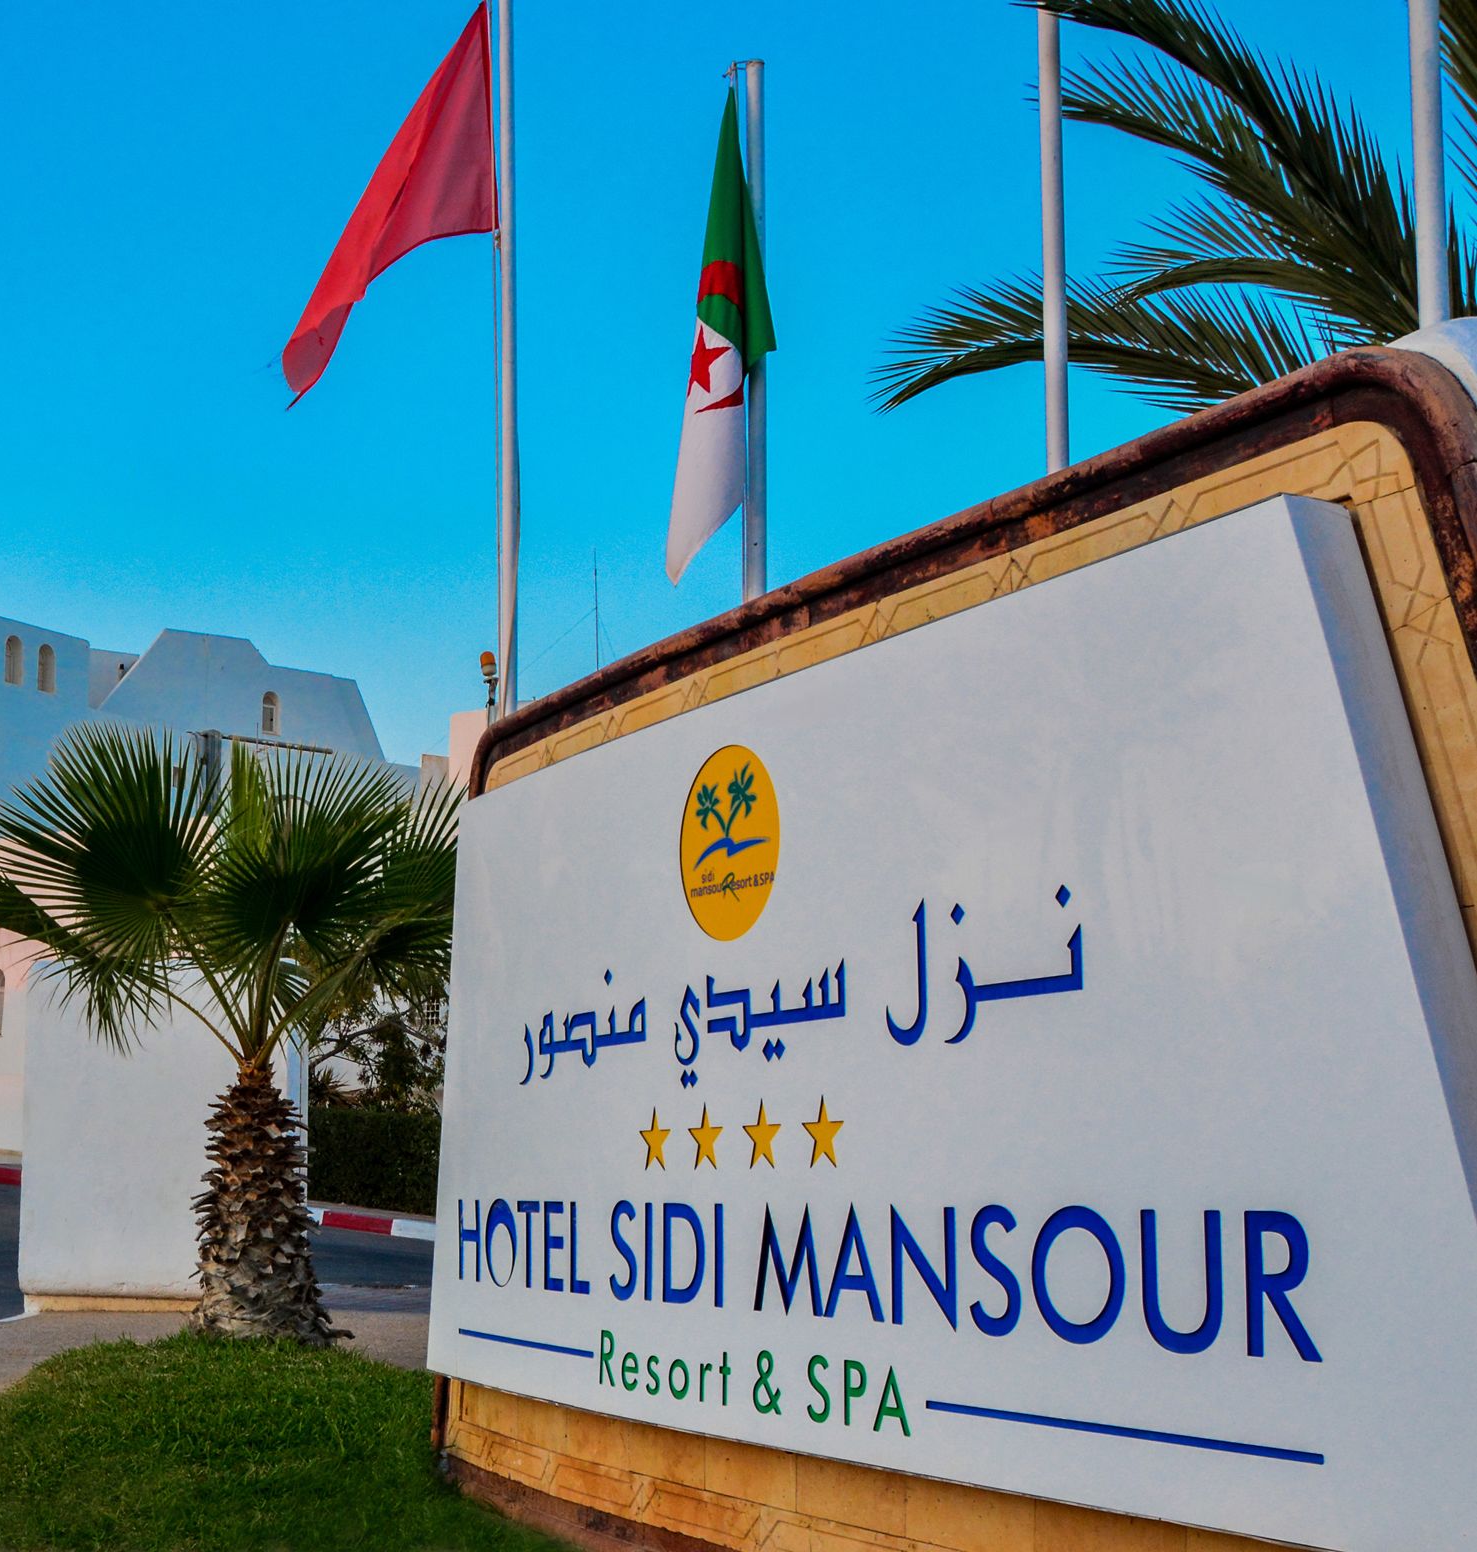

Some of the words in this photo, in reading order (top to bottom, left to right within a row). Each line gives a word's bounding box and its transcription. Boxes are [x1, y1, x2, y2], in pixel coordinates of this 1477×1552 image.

[753, 874, 759, 887] &
[760, 871, 775, 886] SPA
[520, 968, 647, 1085] منصور
[674, 958, 847, 1089] سيدي
[885, 884, 1084, 1046] نزل
[458, 1198, 591, 1296] HOTEL
[609, 1199, 726, 1308] SIDI
[754, 1203, 1324, 1363] MANSOUR
[599, 1329, 732, 1407] Resort
[753, 1349, 783, 1416] &
[807, 1354, 912, 1438] SPA
